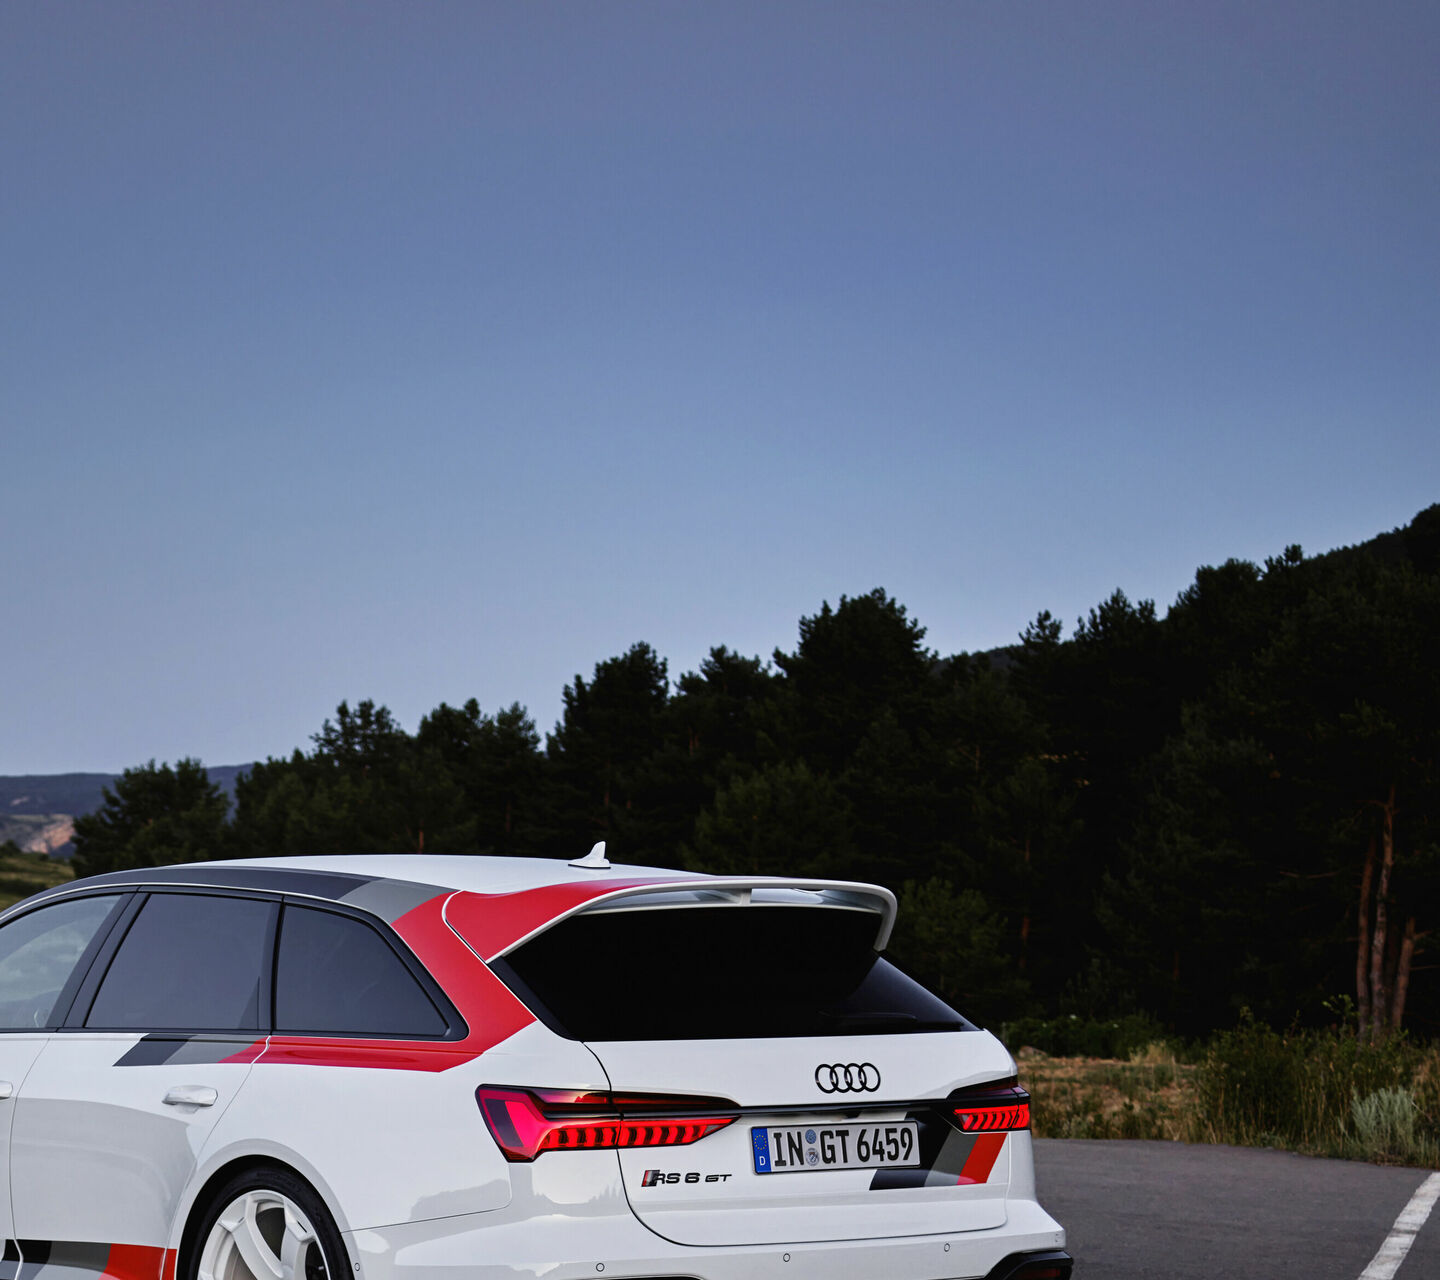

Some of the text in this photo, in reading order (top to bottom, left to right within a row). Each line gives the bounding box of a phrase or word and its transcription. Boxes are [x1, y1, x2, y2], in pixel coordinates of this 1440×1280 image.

[773, 1127, 913, 1166] IN GT 6459
[759, 1156, 766, 1166] D
[653, 1172, 732, 1184] RS 6 GT
